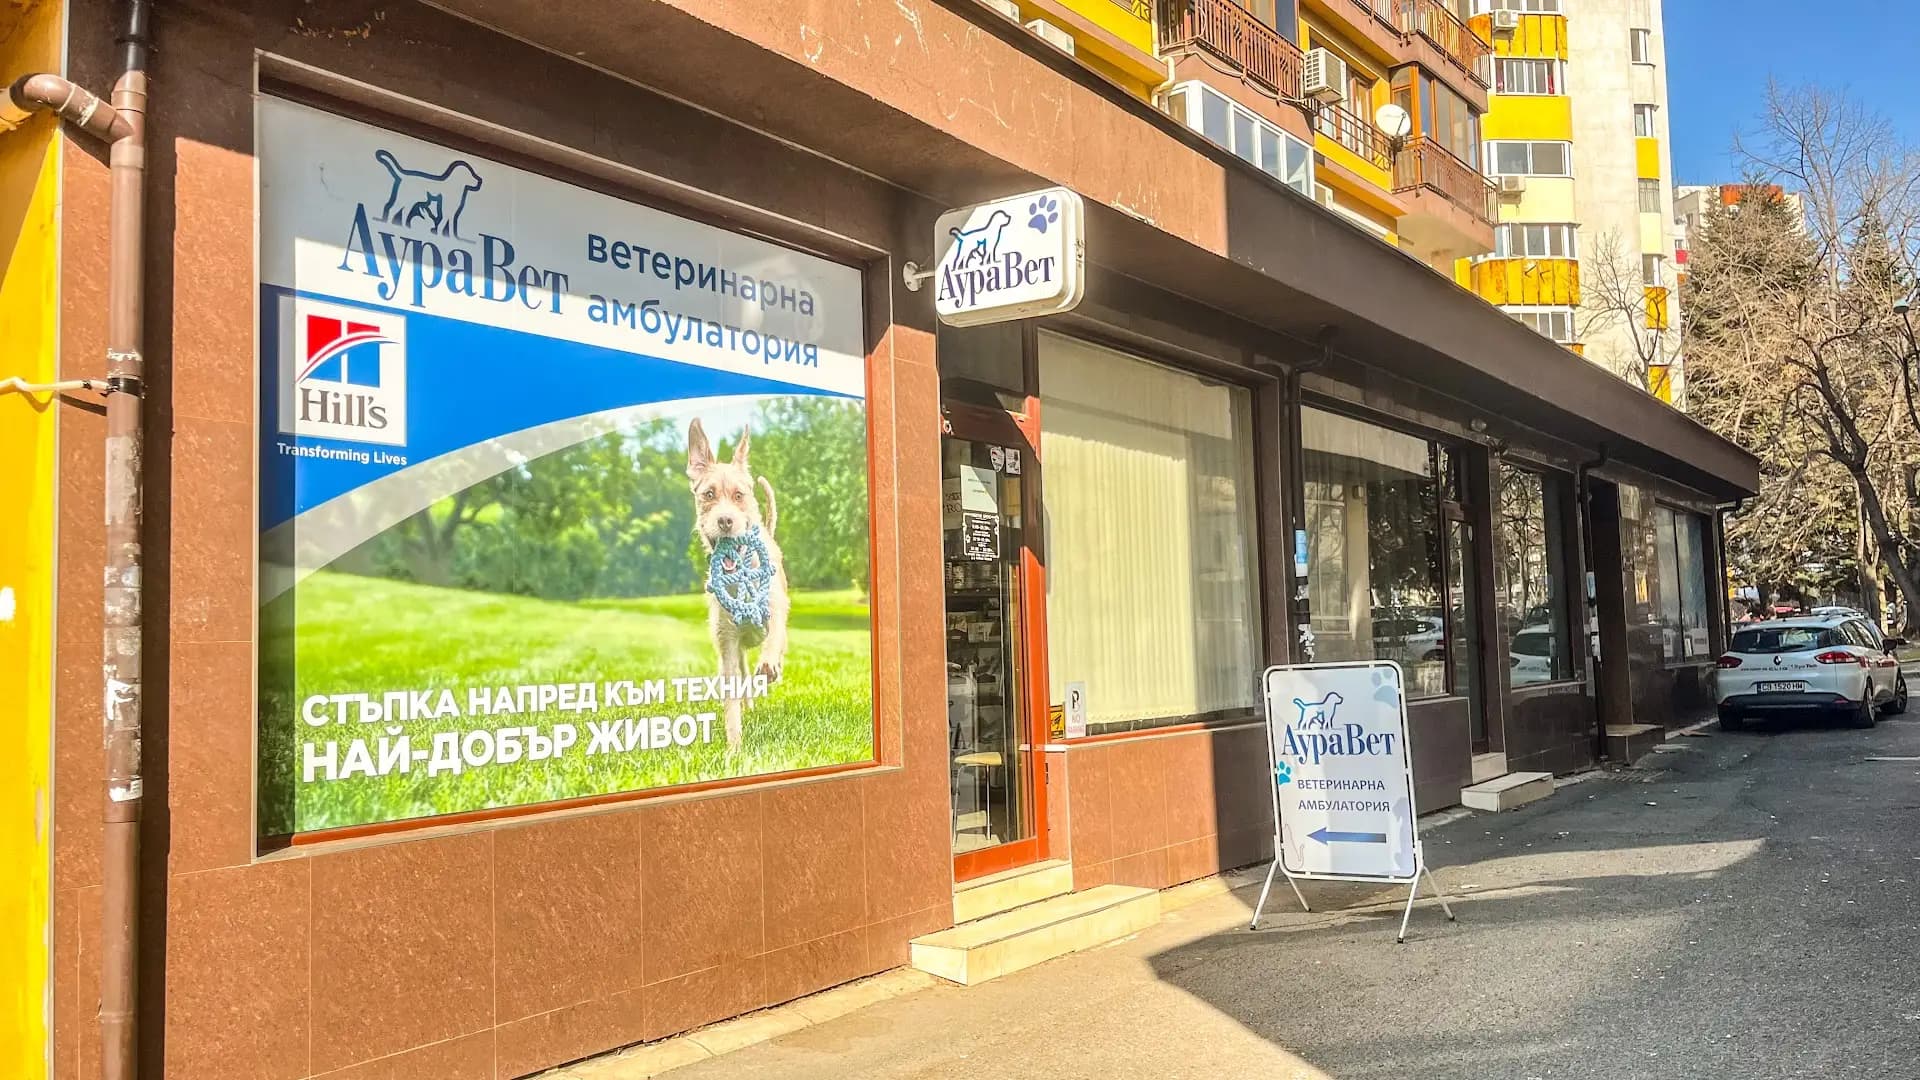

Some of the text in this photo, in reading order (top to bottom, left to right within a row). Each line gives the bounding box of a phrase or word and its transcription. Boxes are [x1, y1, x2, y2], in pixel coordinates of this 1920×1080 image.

[338, 202, 569, 315] АураВет
[587, 232, 816, 317] ветеринарна
[938, 251, 1055, 309] АураВет
[587, 291, 819, 368] амбулатория
[299, 387, 388, 429] Hill's
[276, 442, 408, 466] Transforming Lives
[302, 673, 769, 727] СТЪПКА НАПРЕД КЪМ ТЕХНИЯ
[302, 712, 718, 783] НАЙ-ДОБЪР ЖИВОТ
[1281, 723, 1396, 764] АураВет
[1297, 779, 1386, 791] ВЕТЕРИНАРНА
[1298, 800, 1390, 812] АМБУЛАТОРИЯ
